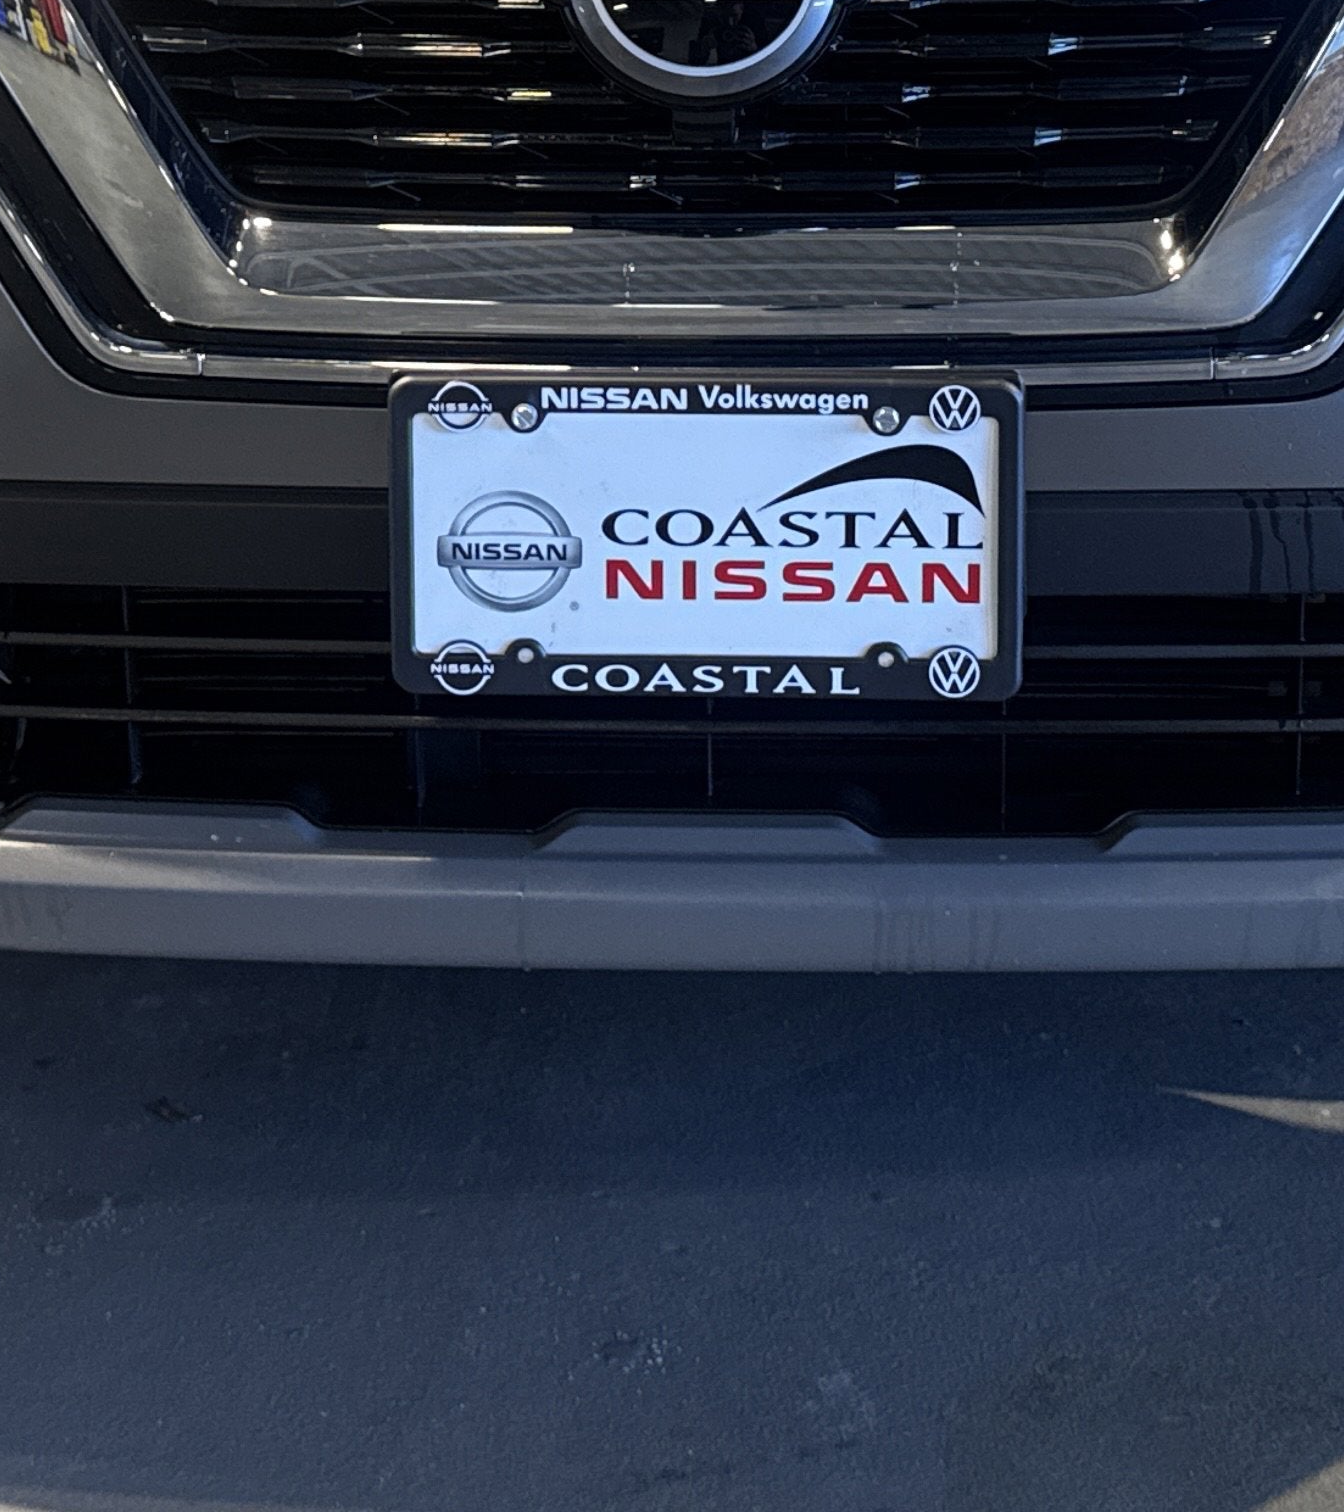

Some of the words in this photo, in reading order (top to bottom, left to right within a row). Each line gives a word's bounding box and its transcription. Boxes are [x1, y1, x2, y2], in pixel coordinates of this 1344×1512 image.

[427, 401, 493, 414] NISSAN
[541, 387, 688, 410] NISSAN
[698, 384, 869, 414] Volkswagen
[601, 506, 983, 549] COASTAL
[452, 542, 567, 562] NISSAN
[605, 559, 981, 604] NISSAN
[430, 663, 494, 675] NISSAN
[551, 662, 860, 695] COASTAL
